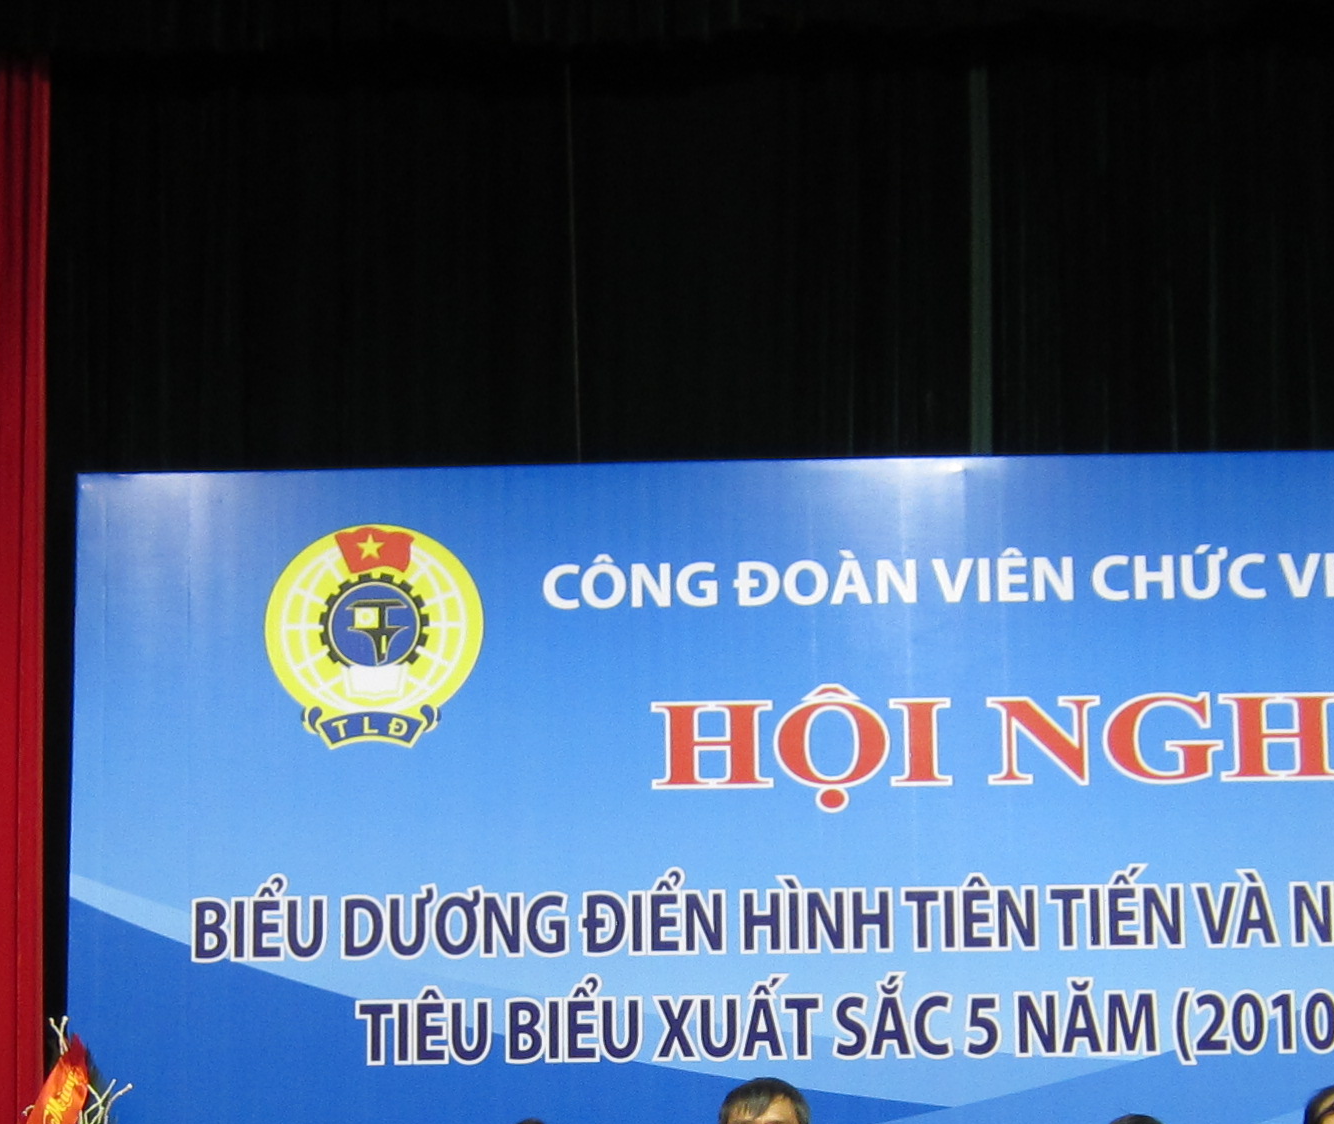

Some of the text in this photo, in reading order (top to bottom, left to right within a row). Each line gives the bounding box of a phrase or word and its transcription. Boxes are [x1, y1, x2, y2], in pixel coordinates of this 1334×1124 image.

[544, 555, 717, 609] CÔNG
[734, 550, 917, 606] ĐOÀN
[932, 548, 1073, 602] VIÊN
[1093, 545, 1265, 600] CHỨC
[651, 684, 952, 813] HỘI
[193, 876, 325, 960] BIỂU
[343, 885, 567, 957] DƯƠNG
[580, 869, 724, 954] ĐIỂN
[742, 877, 891, 952] HÌNH
[903, 876, 1037, 950] TIÊN
[1049, 866, 1182, 948] TIẾN
[1196, 872, 1277, 946] VÀ
[357, 988, 490, 1063] TIÊU
[507, 977, 640, 1062] BIỂU
[657, 976, 820, 1060] XUẤT
[836, 975, 951, 1058] SẮC
[966, 997, 1000, 1057] 5
[1017, 980, 1158, 1054] NĂM
